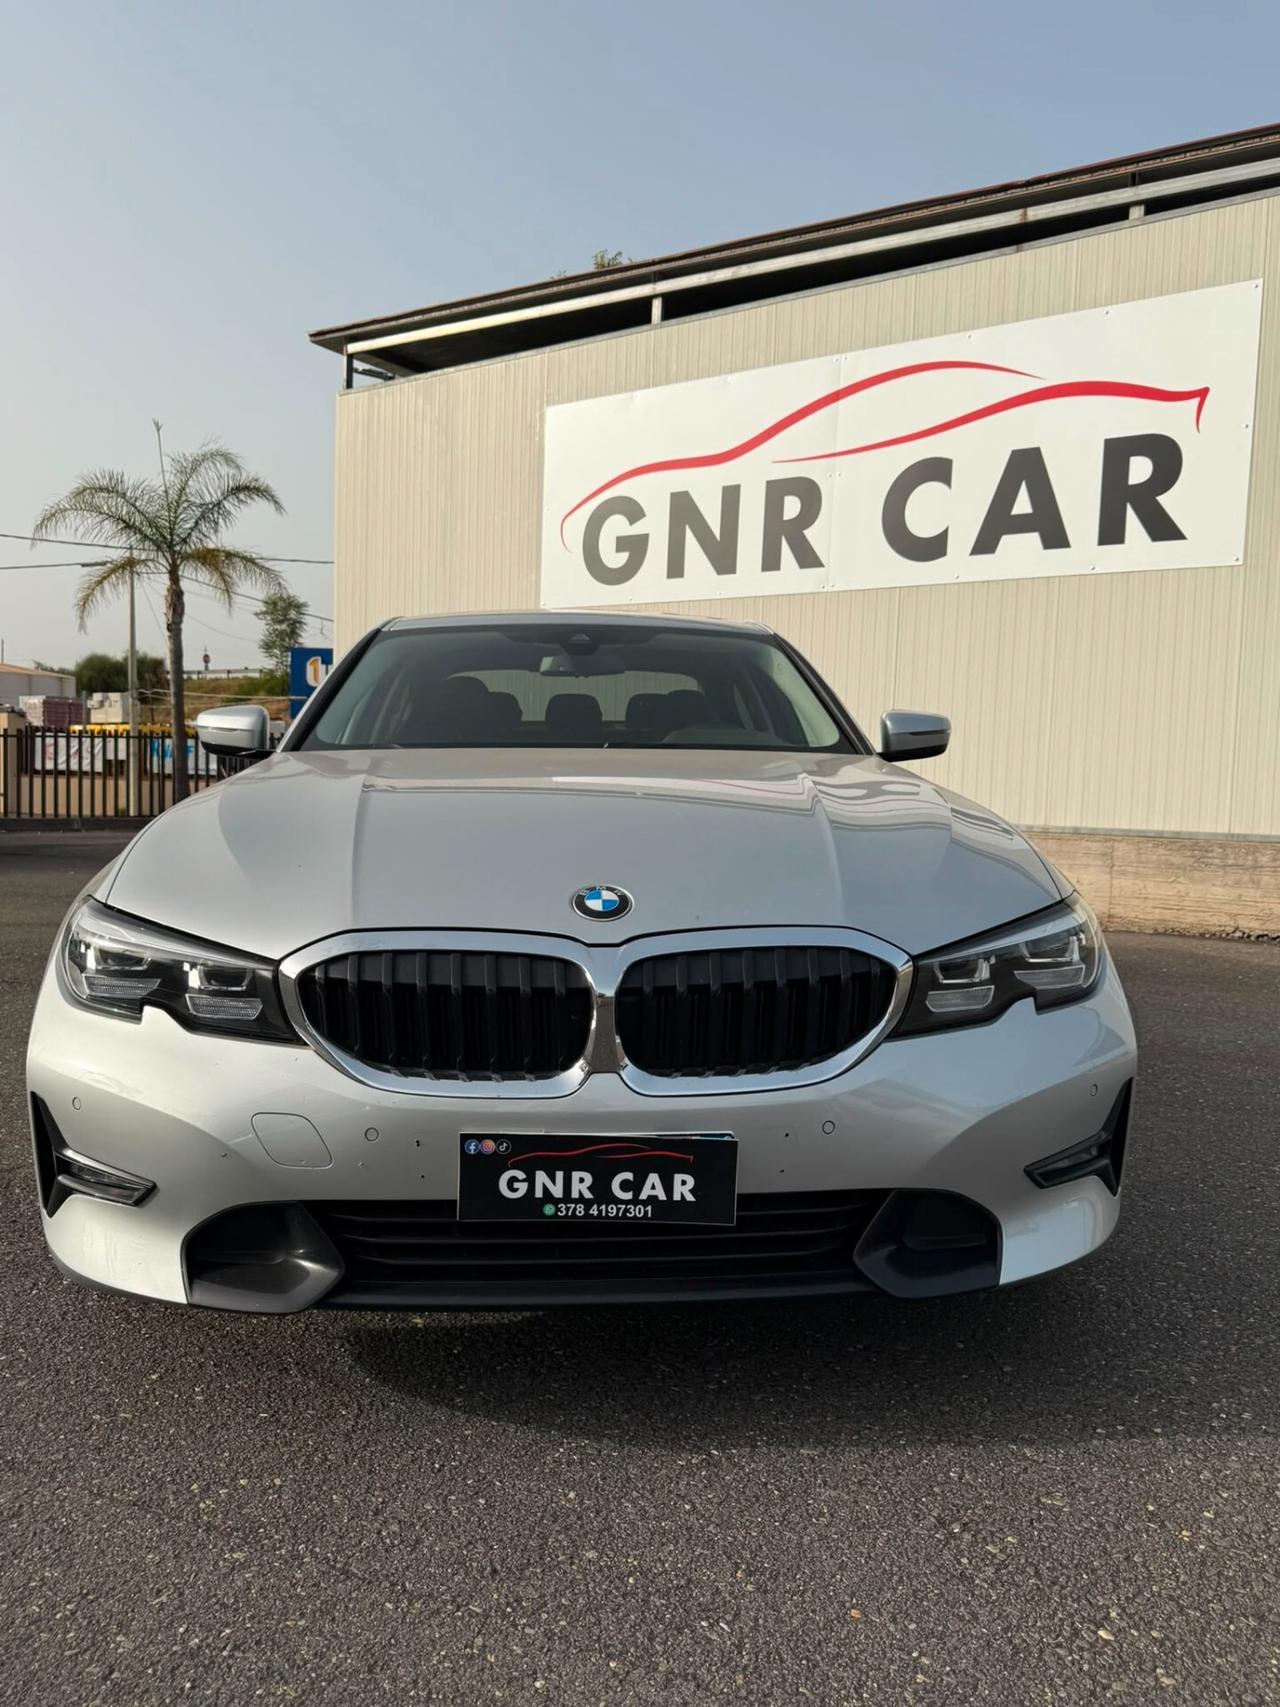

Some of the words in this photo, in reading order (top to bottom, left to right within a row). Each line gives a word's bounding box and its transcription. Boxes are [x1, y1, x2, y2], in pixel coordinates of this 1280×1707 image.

[583, 477, 825, 586] GNR
[882, 434, 1187, 562] CAR
[498, 1169, 594, 1199] GNR
[611, 1172, 696, 1201] CAR
[557, 1203, 585, 1217] 378
[589, 1204, 653, 1218] 4197301
